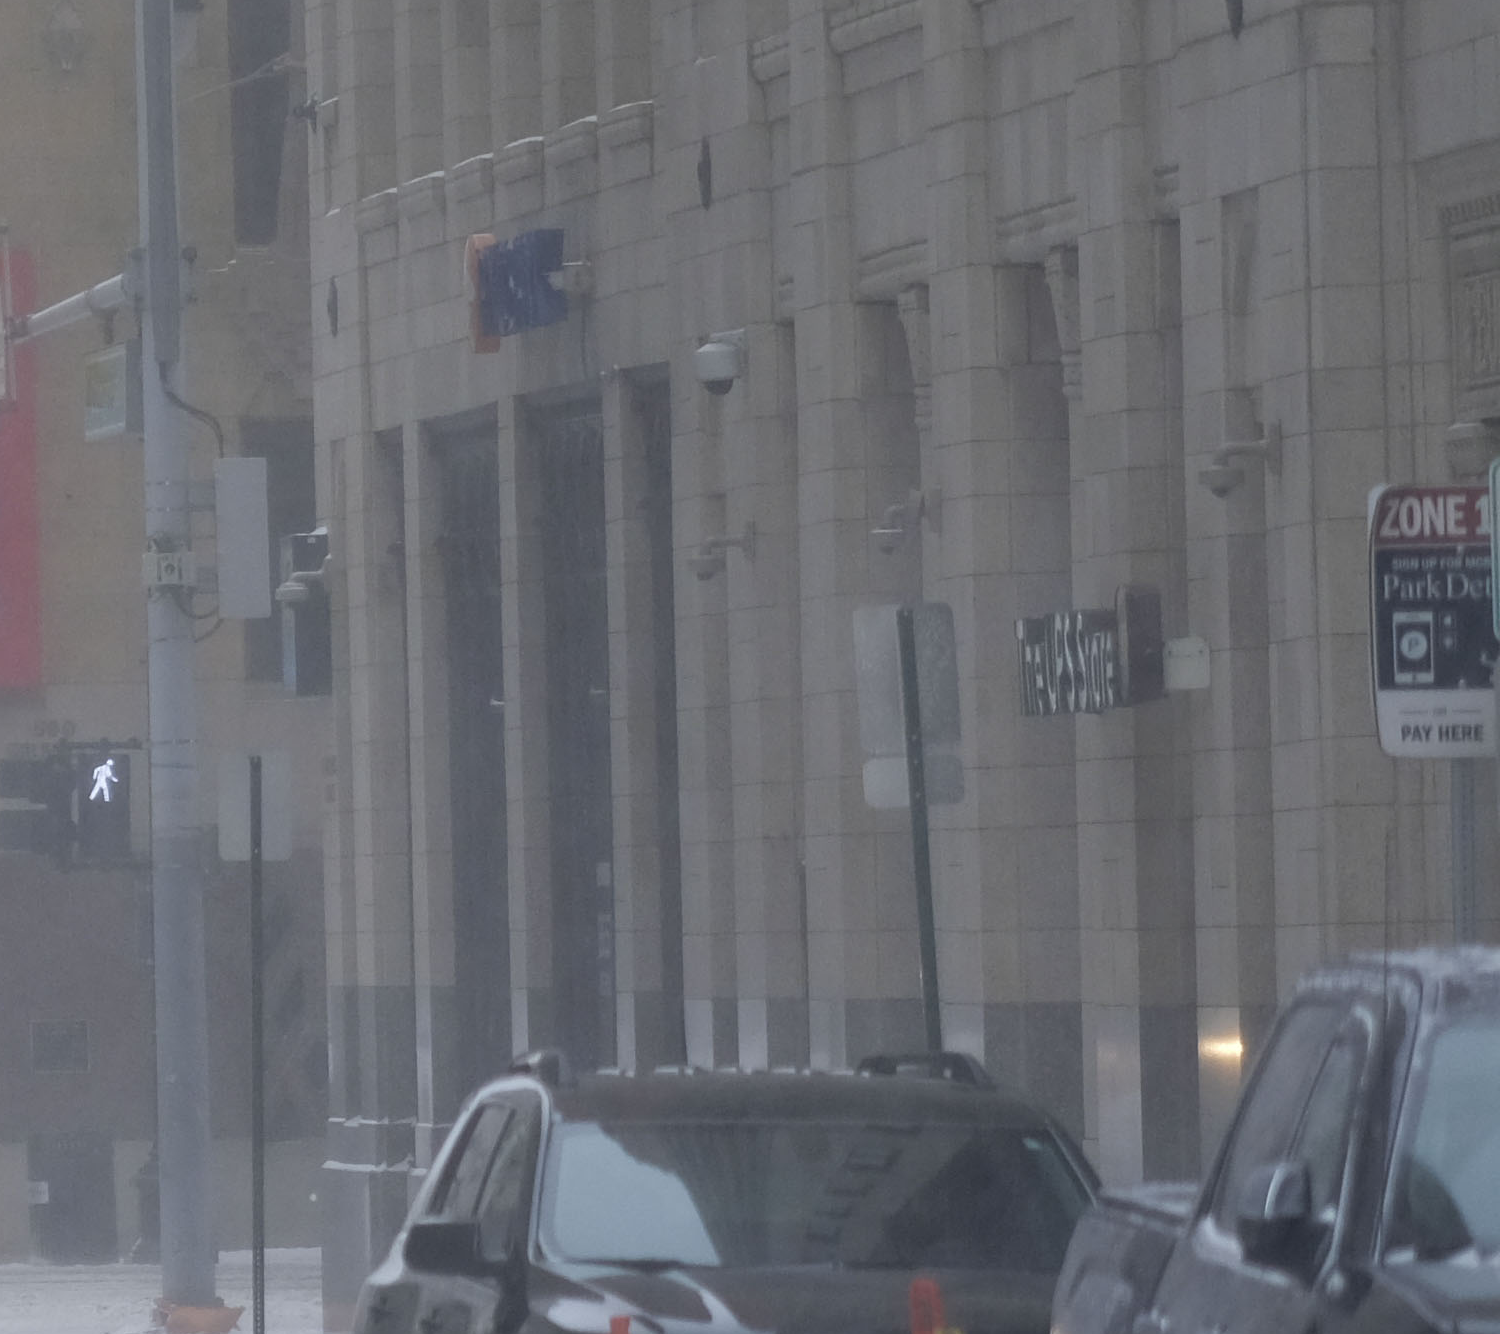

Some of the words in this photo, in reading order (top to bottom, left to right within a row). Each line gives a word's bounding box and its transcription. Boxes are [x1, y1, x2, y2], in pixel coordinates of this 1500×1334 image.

[1380, 494, 1467, 539] ZONE
[1392, 557, 1419, 570] SIGN
[1421, 557, 1438, 569] UP
[1440, 556, 1462, 569] FOR
[1383, 573, 1440, 600] Park
[1044, 612, 1075, 713] UPS
[1401, 725, 1432, 742] PAY
[1438, 724, 1483, 742] HERE
